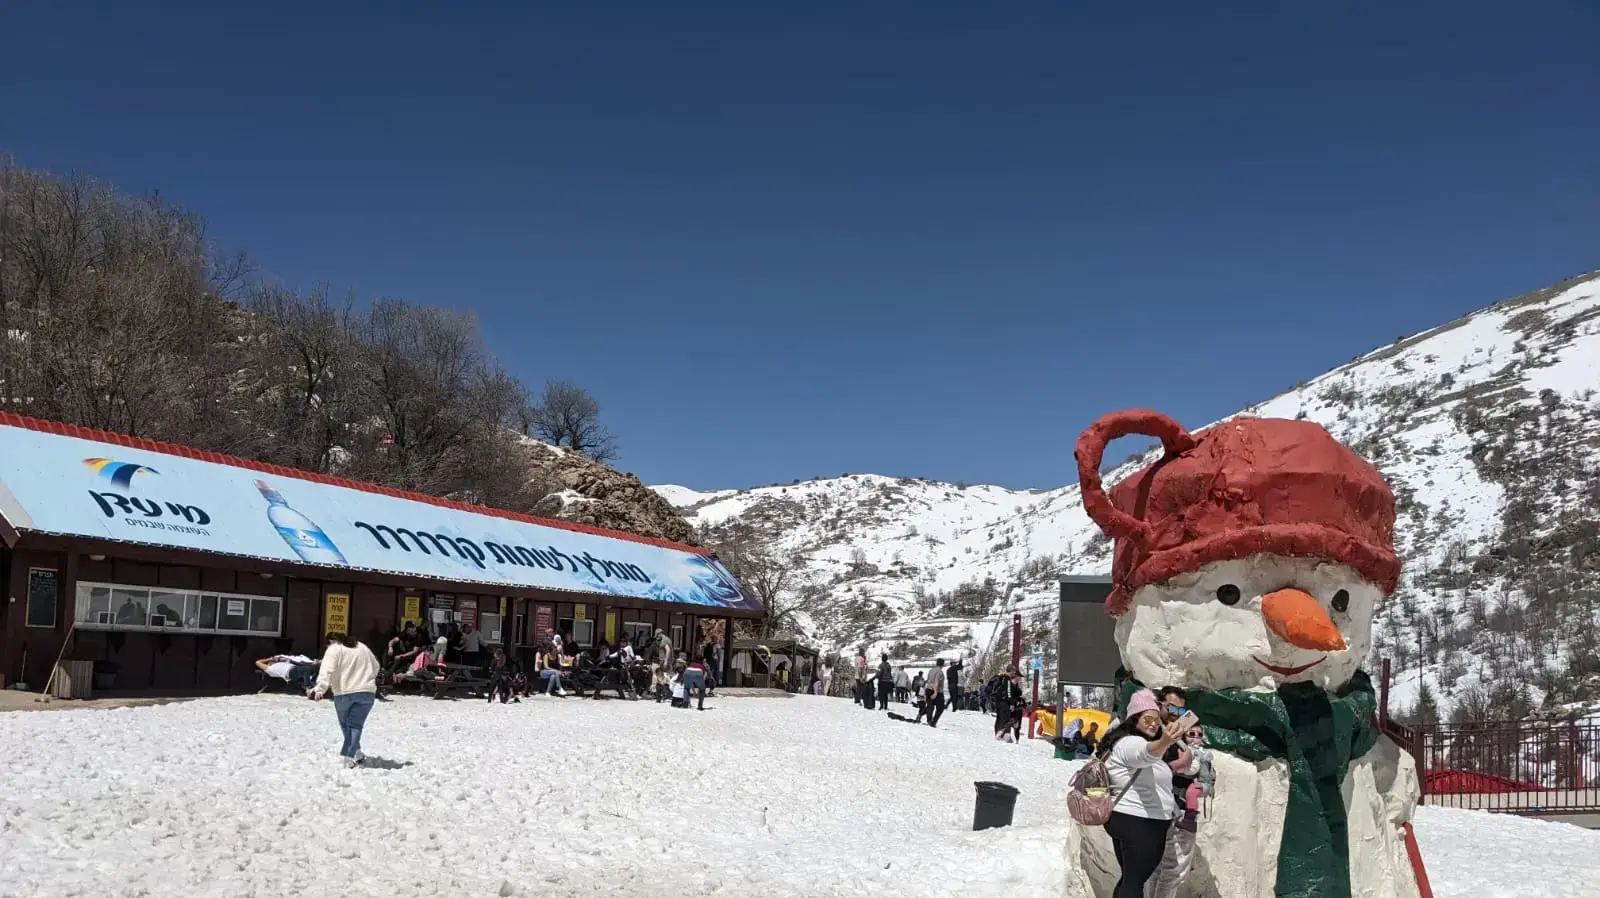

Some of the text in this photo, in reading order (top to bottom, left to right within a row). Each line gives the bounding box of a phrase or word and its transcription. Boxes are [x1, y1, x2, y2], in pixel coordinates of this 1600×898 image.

[88, 489, 211, 525] מי עדן
[124, 517, 166, 530] שבמים
[483, 541, 579, 573] לשתות
[572, 551, 652, 583] מומלץ
